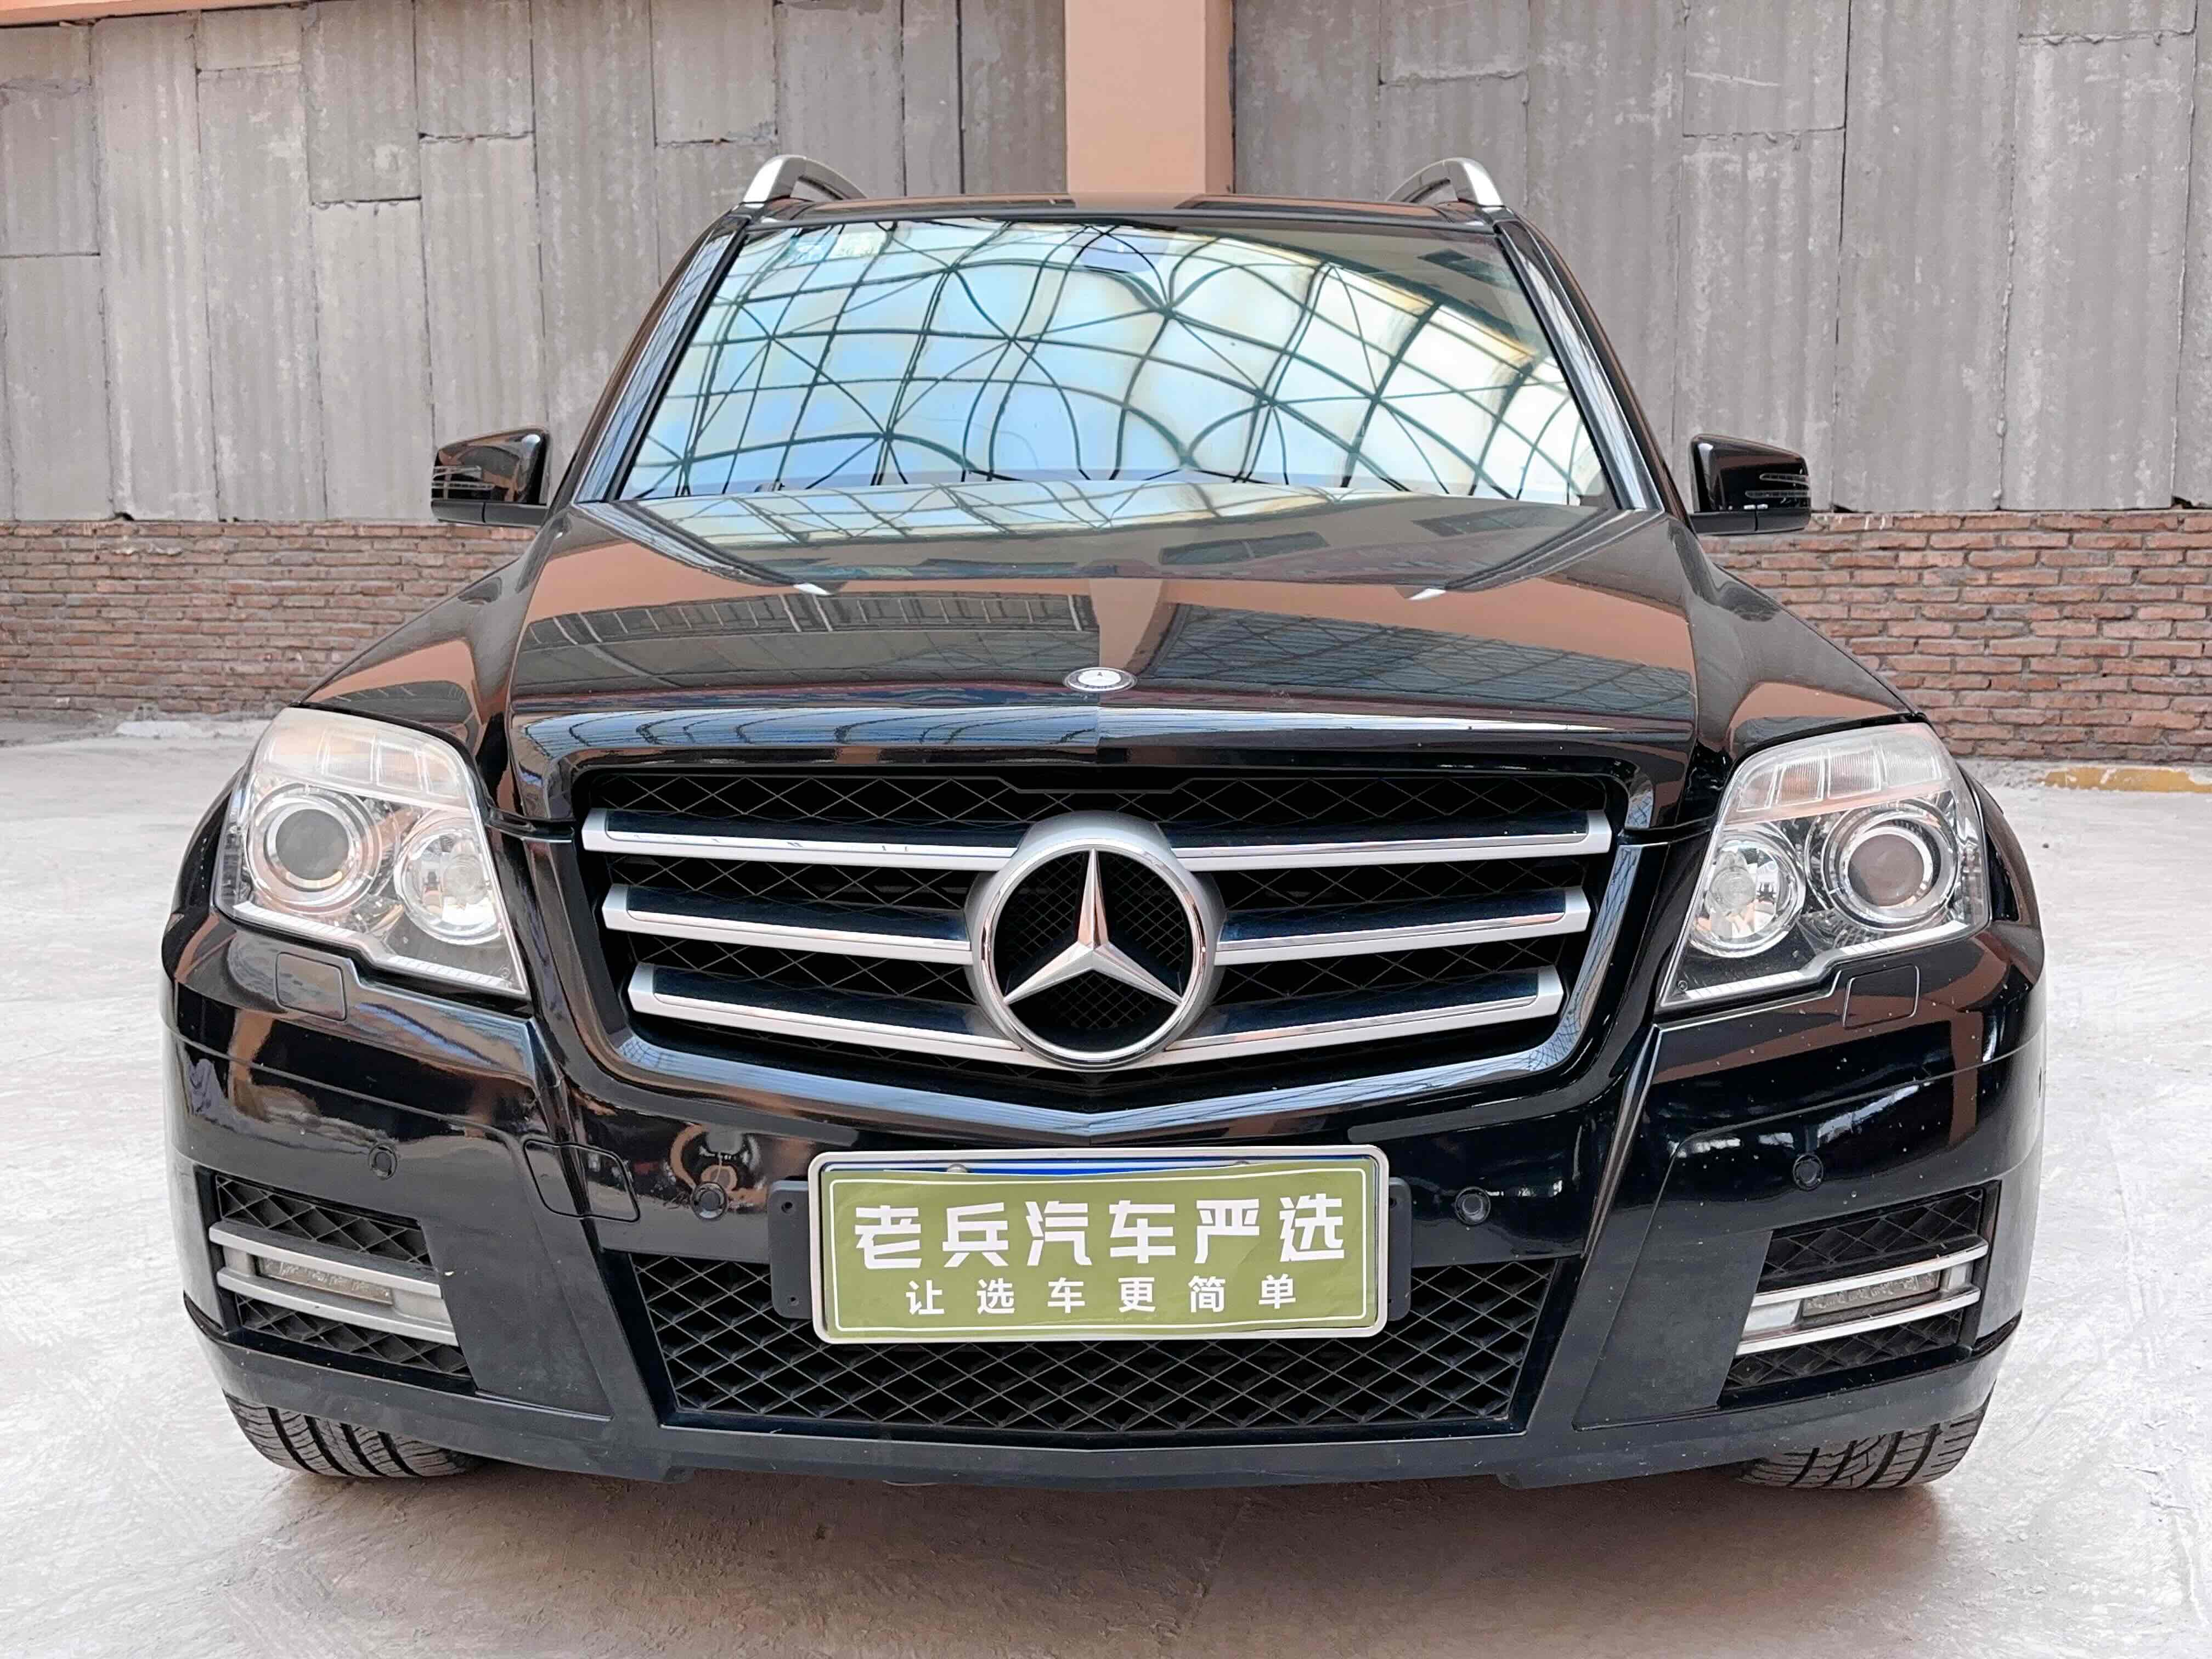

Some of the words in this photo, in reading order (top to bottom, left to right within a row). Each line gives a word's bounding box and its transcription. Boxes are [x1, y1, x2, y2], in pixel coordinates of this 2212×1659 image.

[854, 1193, 1345, 1269] 老兵汽车严选
[905, 1273, 1296, 1315] 让选车更简单
